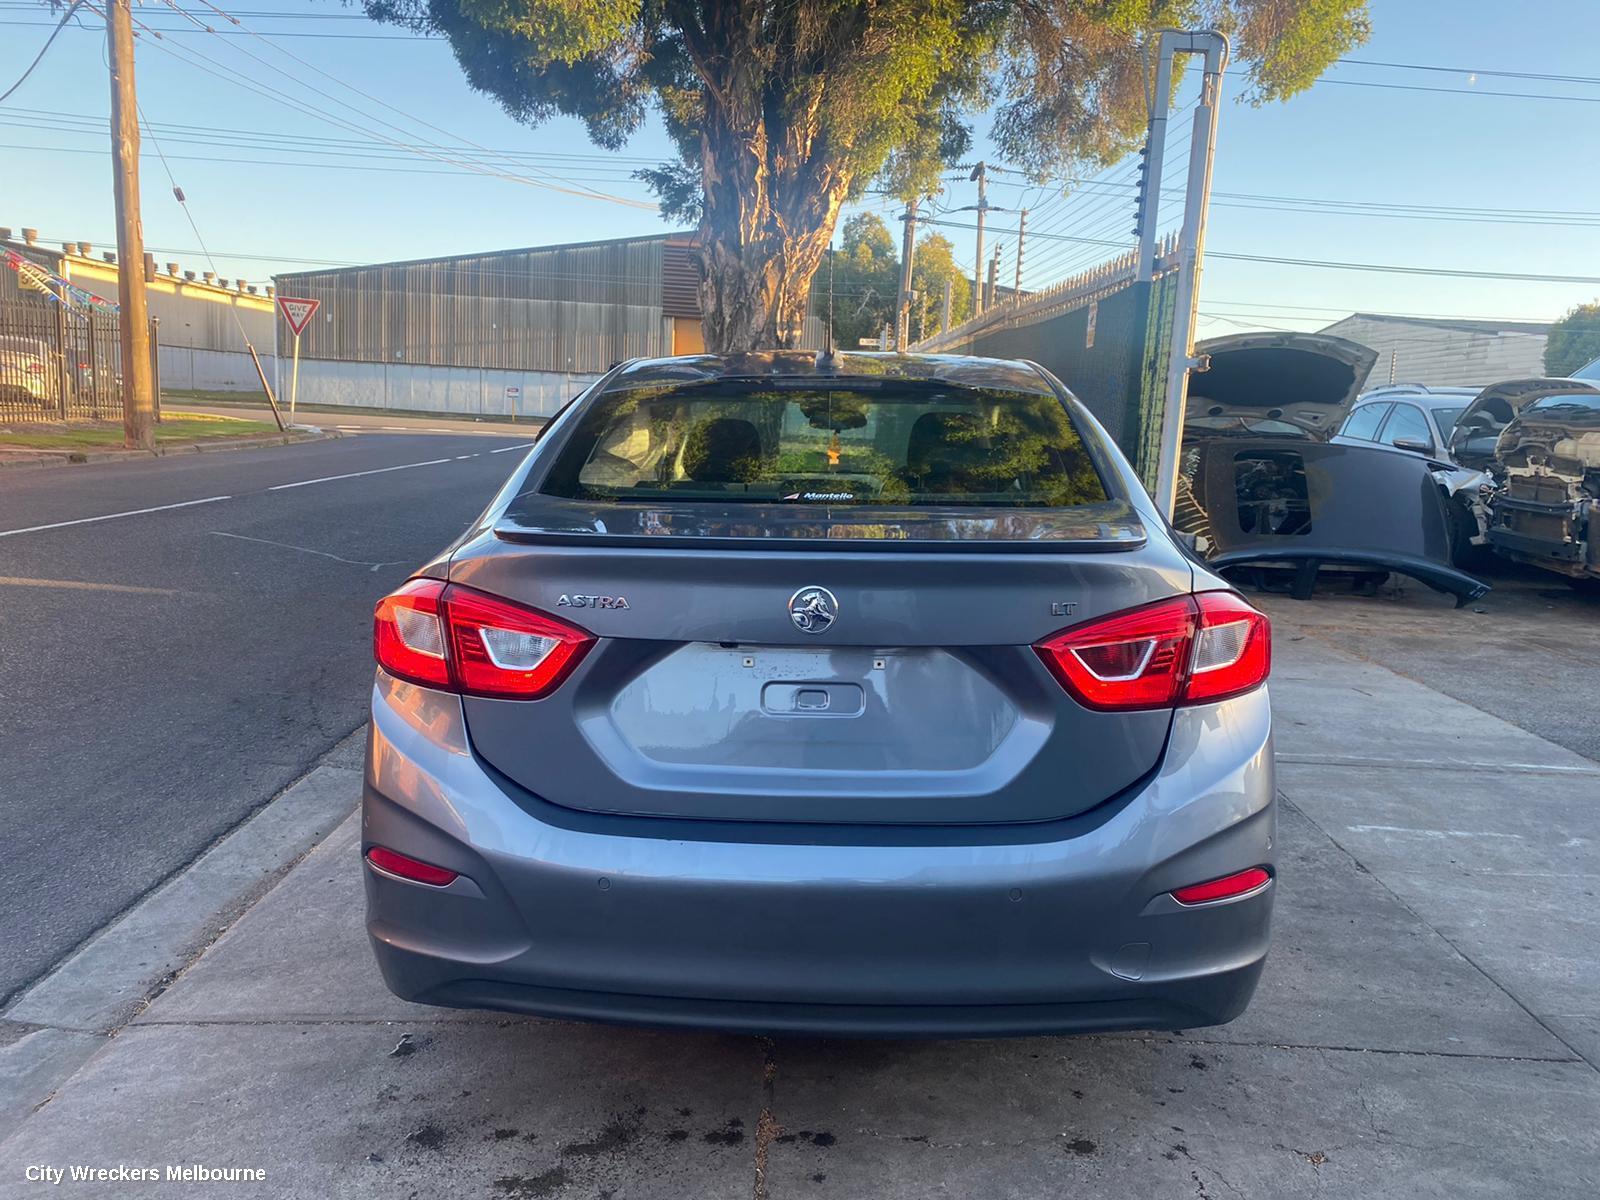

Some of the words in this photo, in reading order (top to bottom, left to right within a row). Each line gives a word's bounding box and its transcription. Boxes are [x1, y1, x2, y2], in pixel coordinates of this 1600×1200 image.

[289, 304, 307, 312] GIVE
[803, 492, 854, 500] Mantello
[556, 594, 630, 610] ASTRA
[1051, 602, 1078, 616] LT
